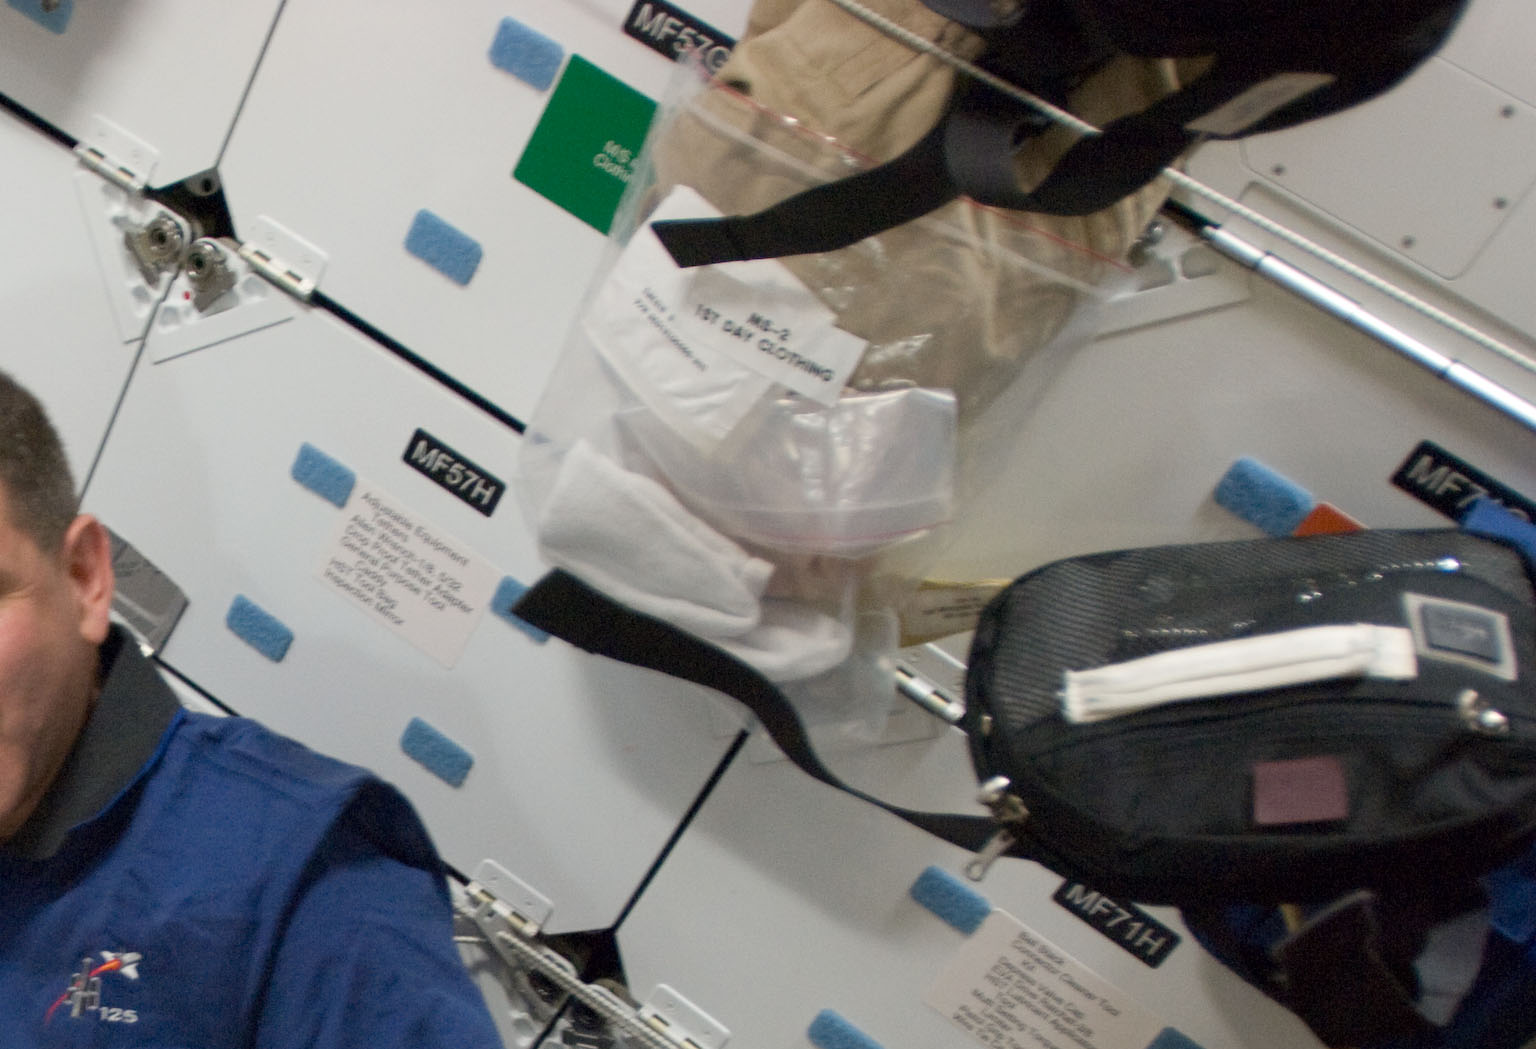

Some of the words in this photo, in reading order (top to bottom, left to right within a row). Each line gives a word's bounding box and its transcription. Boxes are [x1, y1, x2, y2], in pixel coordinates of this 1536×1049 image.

[633, 3, 730, 75] MF57G
[695, 304, 721, 324] 1ST
[721, 319, 754, 342] DAY
[757, 337, 836, 383] CLOTHING
[747, 311, 791, 341] MS-2
[410, 441, 498, 508] MF57H
[415, 526, 470, 566] Equipment
[1064, 882, 1167, 956] MF71H
[99, 1006, 139, 1023] 125
